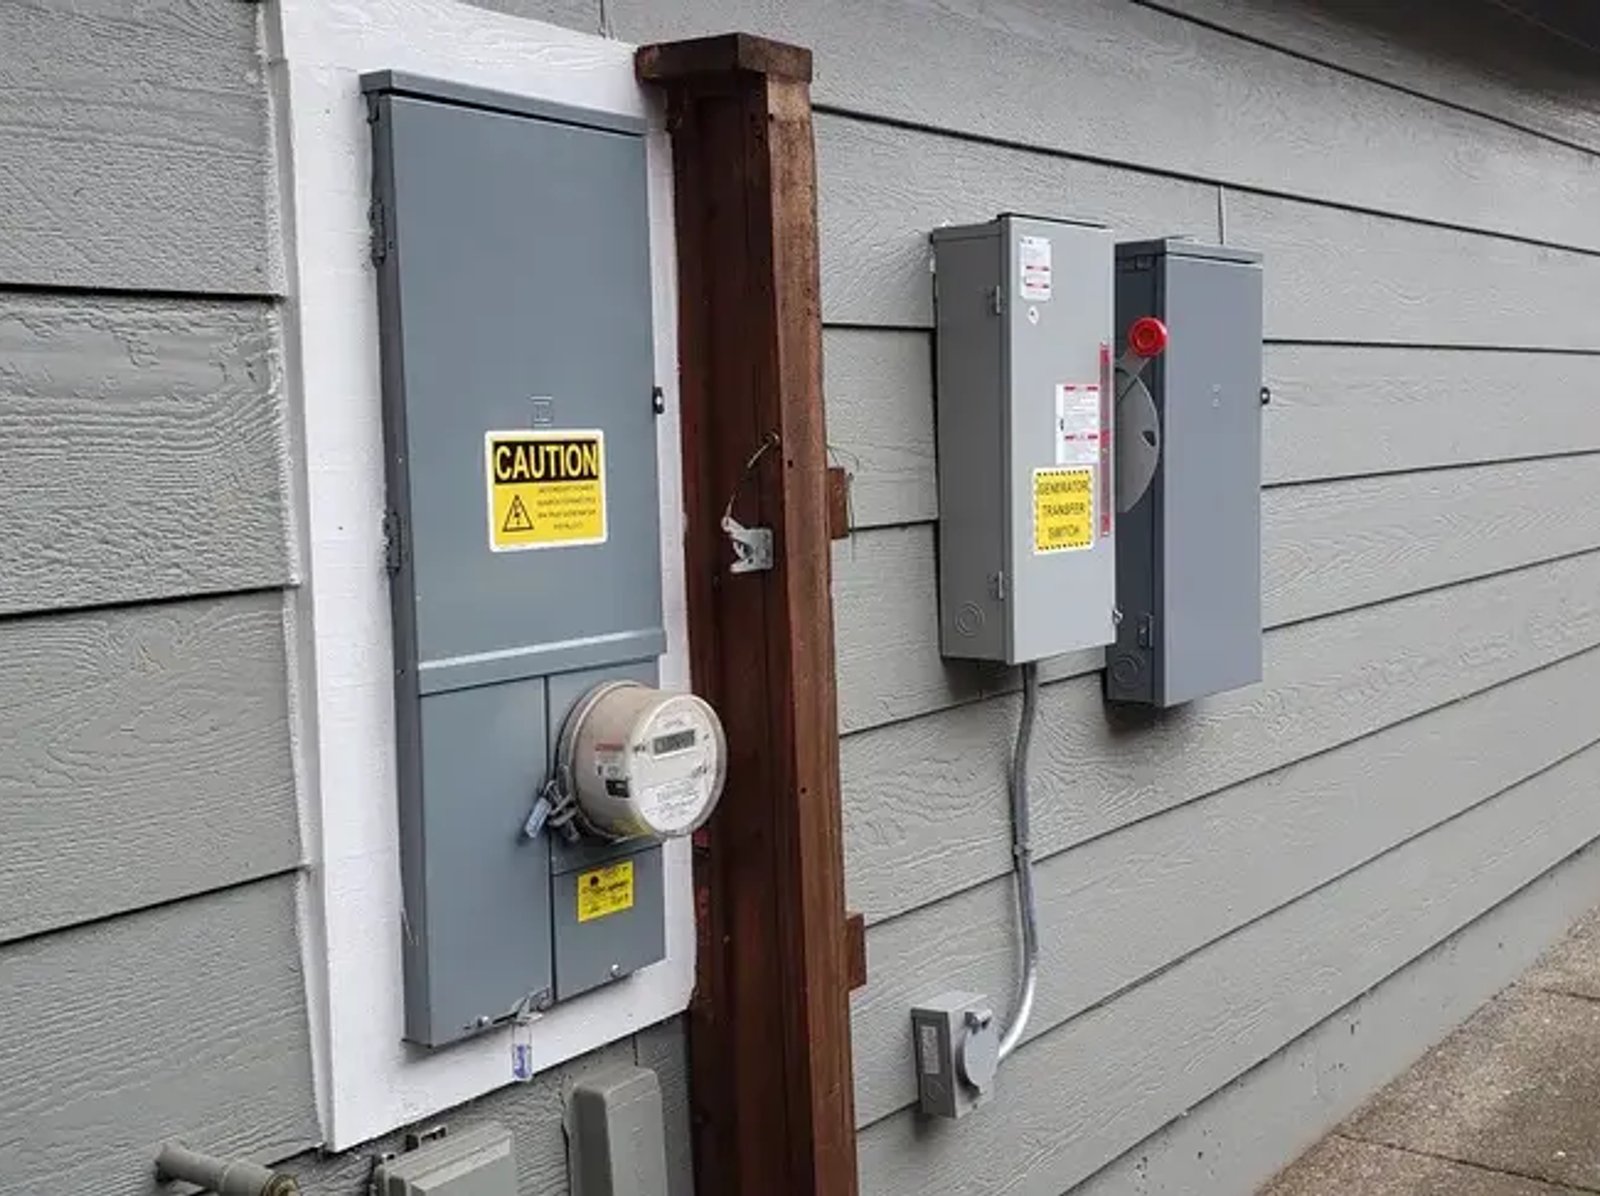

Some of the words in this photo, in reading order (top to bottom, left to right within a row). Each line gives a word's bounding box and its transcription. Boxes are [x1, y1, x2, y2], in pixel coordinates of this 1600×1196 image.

[496, 443, 597, 480] CAUTION
[1038, 480, 1088, 495] GENERATOR
[1043, 502, 1085, 517] TRANSFER
[1048, 525, 1079, 540] SWITCH
